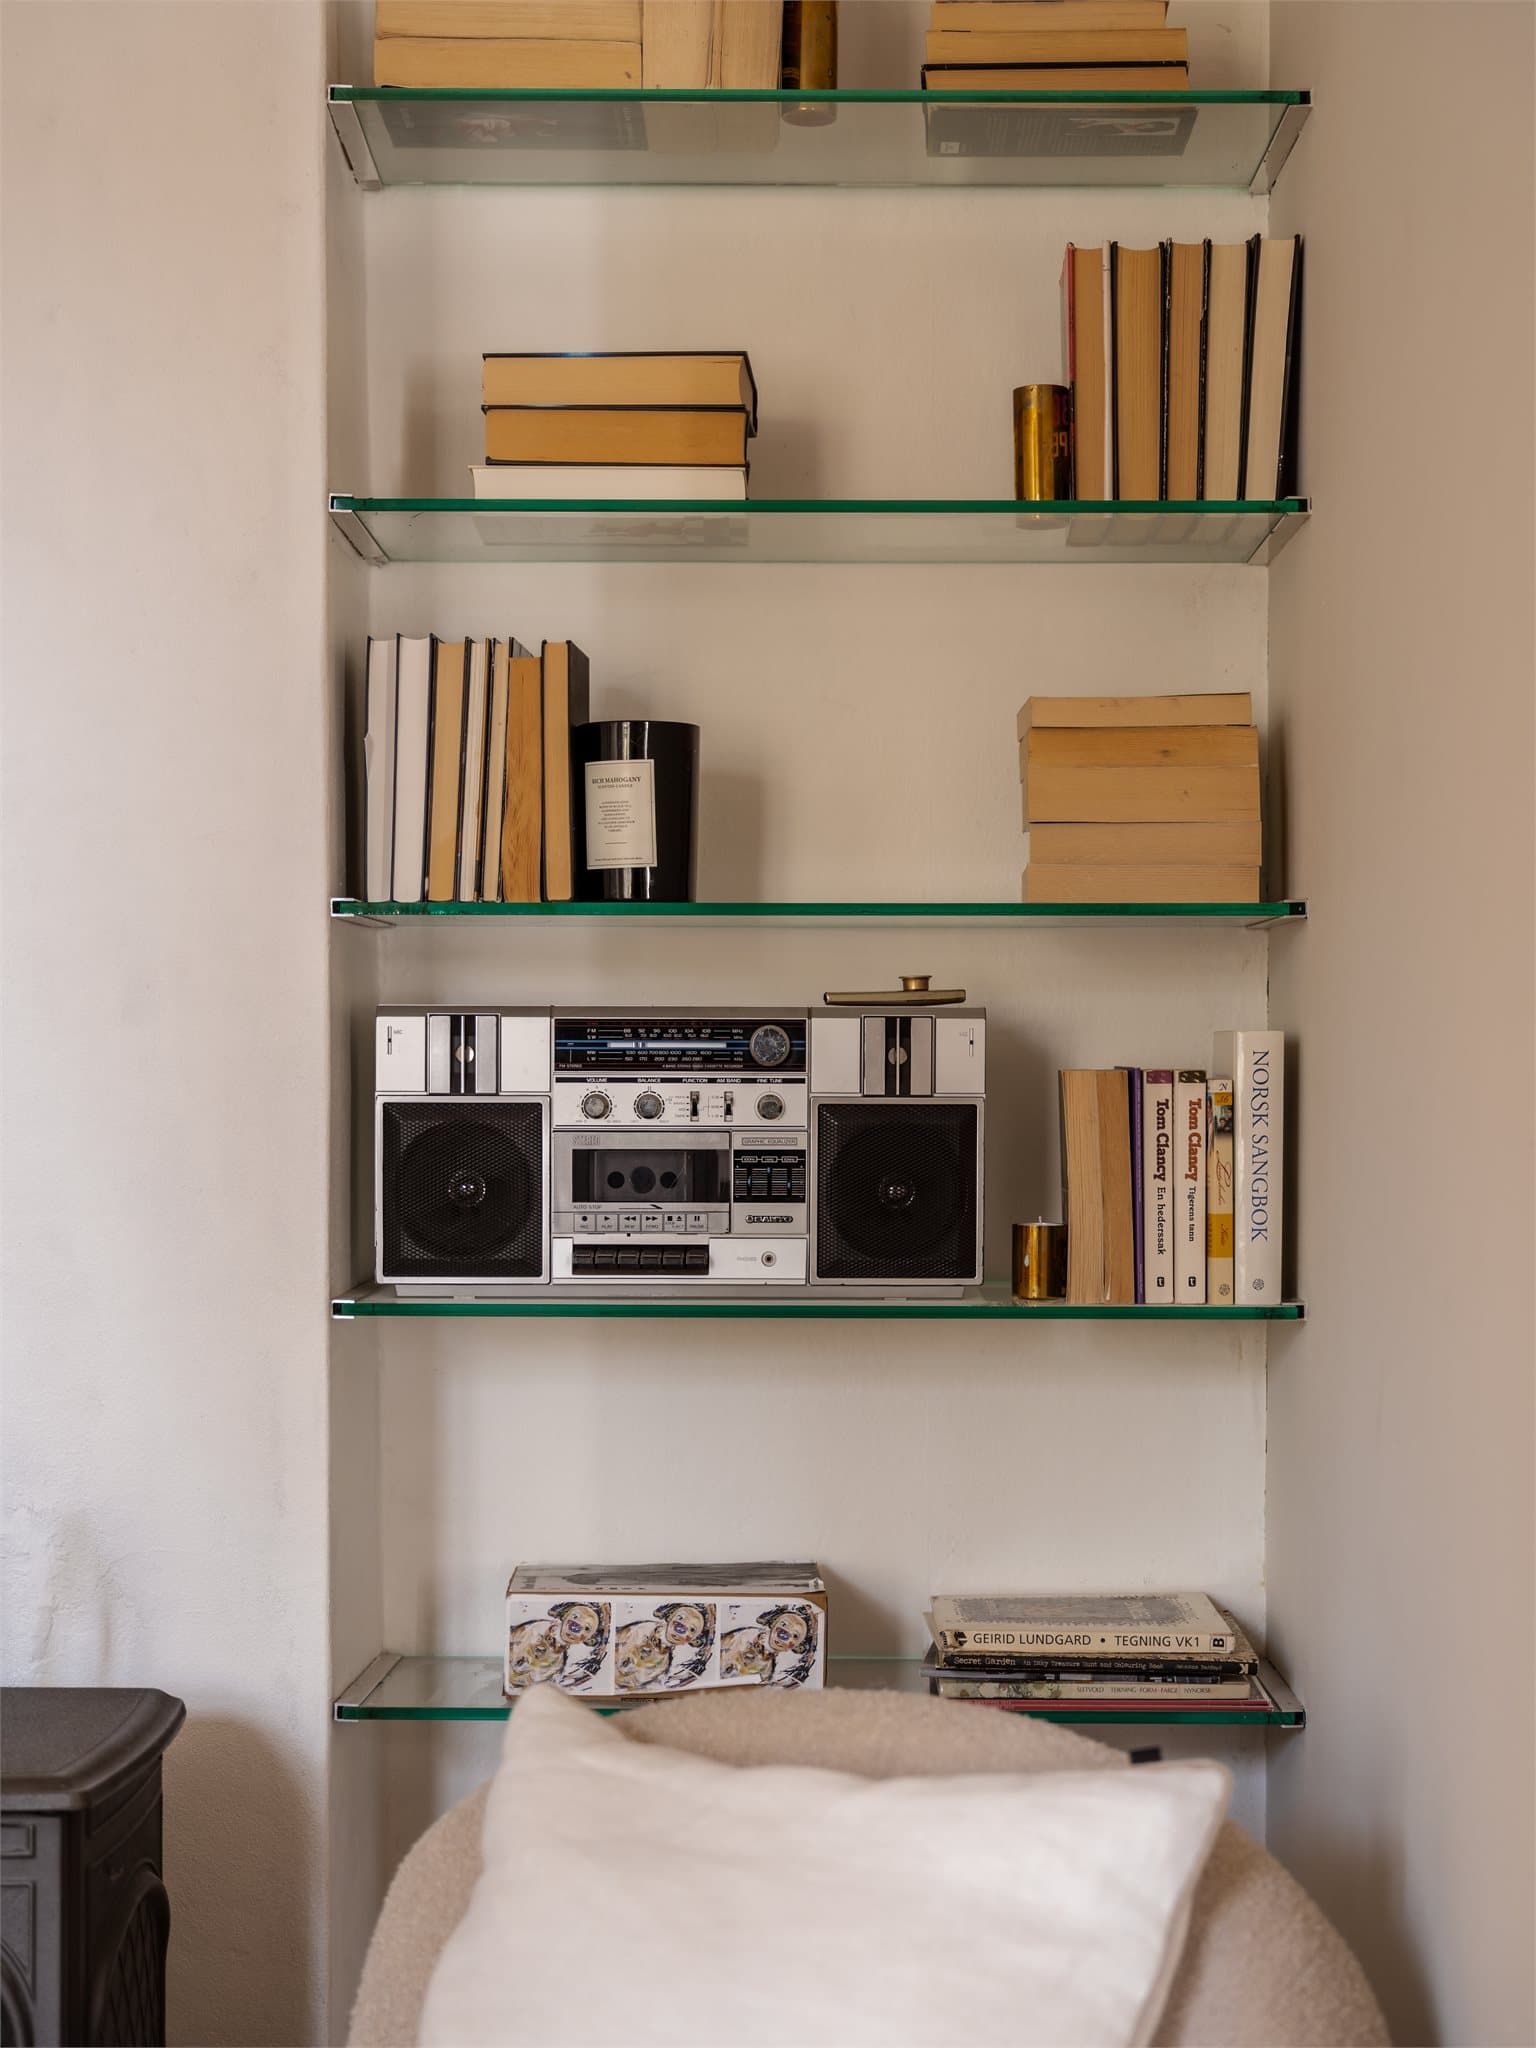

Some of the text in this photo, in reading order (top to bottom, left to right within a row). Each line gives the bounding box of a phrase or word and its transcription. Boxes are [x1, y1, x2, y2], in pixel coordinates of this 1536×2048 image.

[1188, 1098, 1201, 1130] Tom
[1185, 1132, 1201, 1182] Clancy
[1251, 1050, 1270, 1242] NORSK SANGBOK
[1153, 1099, 1169, 1256] Tom Clancy En hederssak
[1187, 1186, 1196, 1222] Tigerens
[973, 1632, 1200, 1647] GEIRID LUNDGARD TEGNING VK1
[954, 1656, 982, 1666] Secret
[984, 1656, 1016, 1667] Garden
